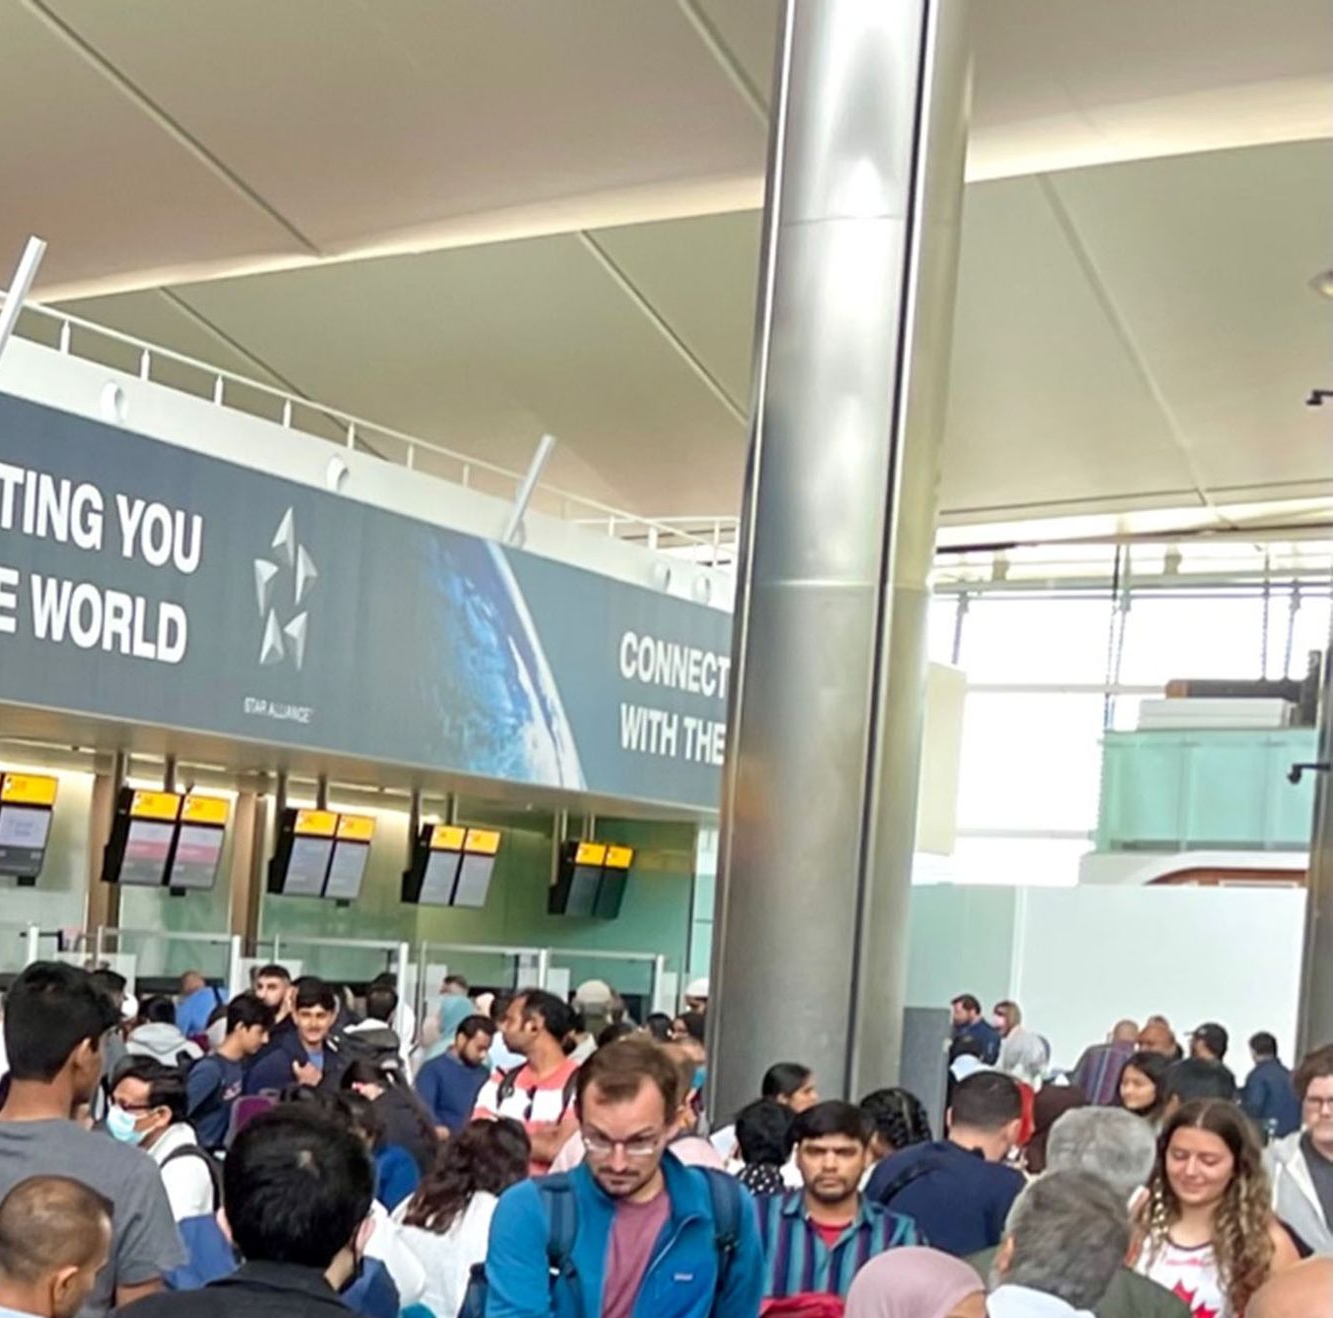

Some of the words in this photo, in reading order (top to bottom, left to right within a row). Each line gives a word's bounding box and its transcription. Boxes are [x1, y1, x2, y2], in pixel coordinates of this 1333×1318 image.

[115, 493, 203, 574] YOU
[31, 573, 188, 664] WORLD
[620, 630, 731, 699] CONNECT
[620, 702, 679, 758] WITH
[683, 716, 726, 766] THE
